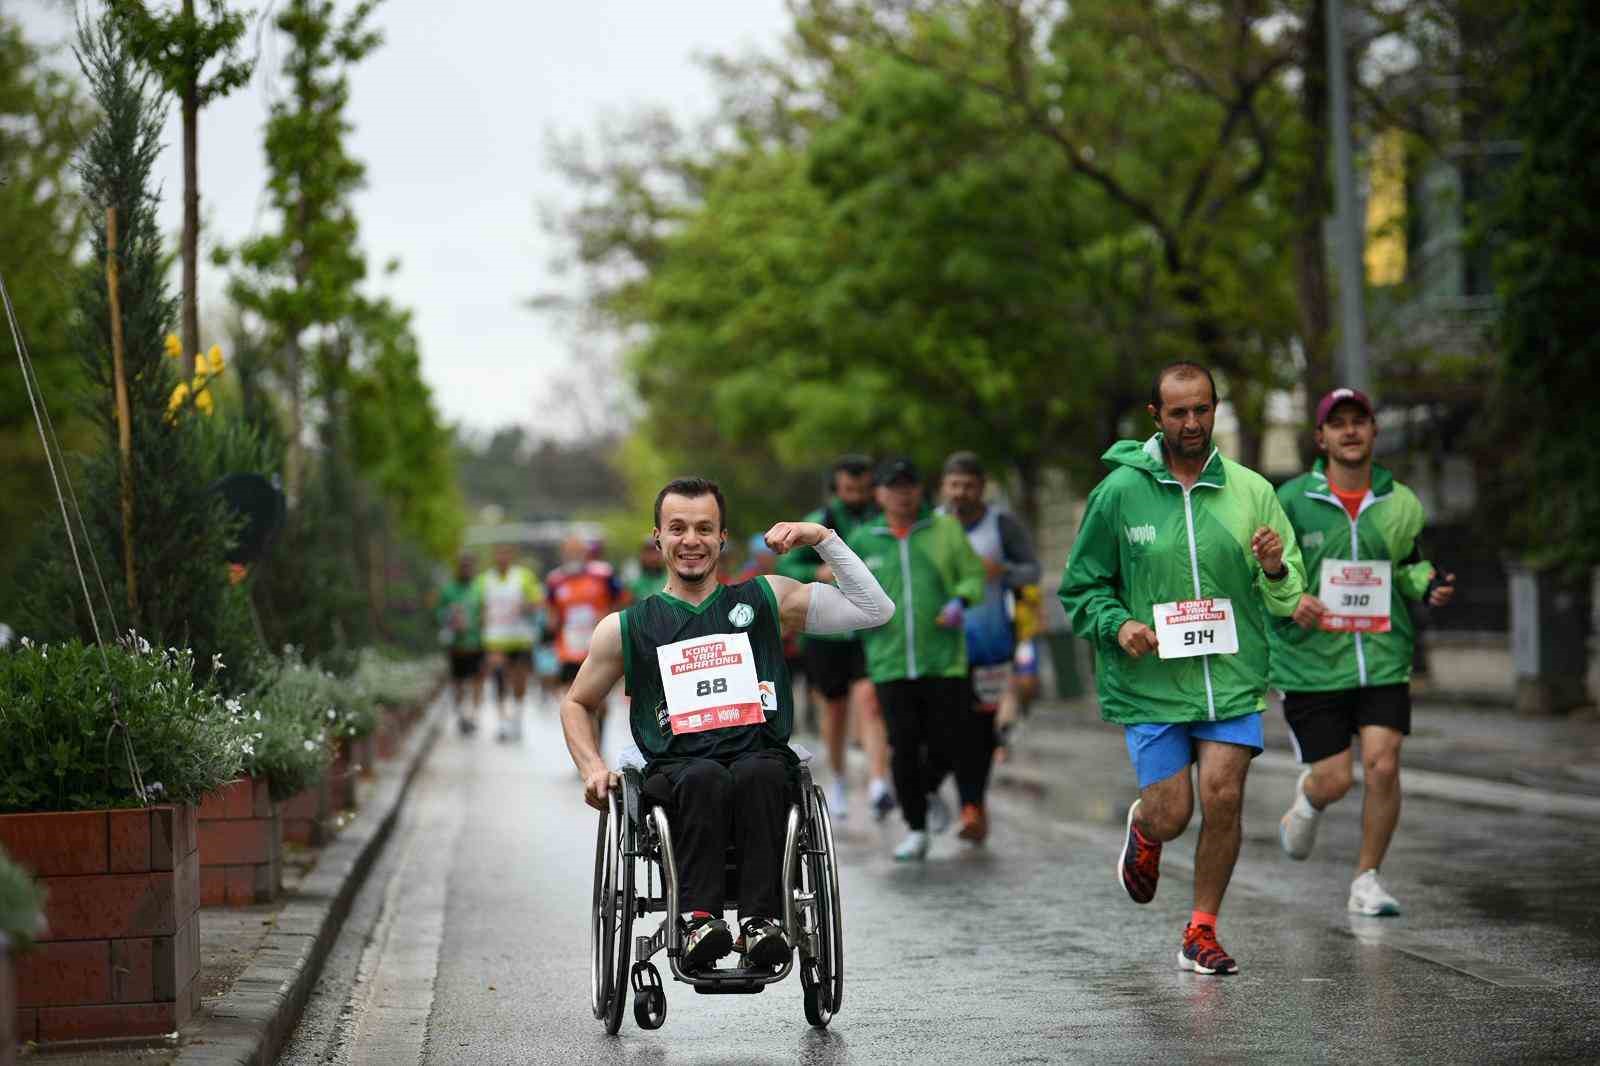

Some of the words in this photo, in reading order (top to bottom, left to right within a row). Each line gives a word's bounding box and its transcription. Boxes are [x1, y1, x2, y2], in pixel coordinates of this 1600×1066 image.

[1342, 594, 1370, 606] 310
[1184, 629, 1214, 646] 914
[685, 643, 723, 656] KONYA
[675, 655, 738, 673] MARATONU
[696, 677, 728, 697] 88
